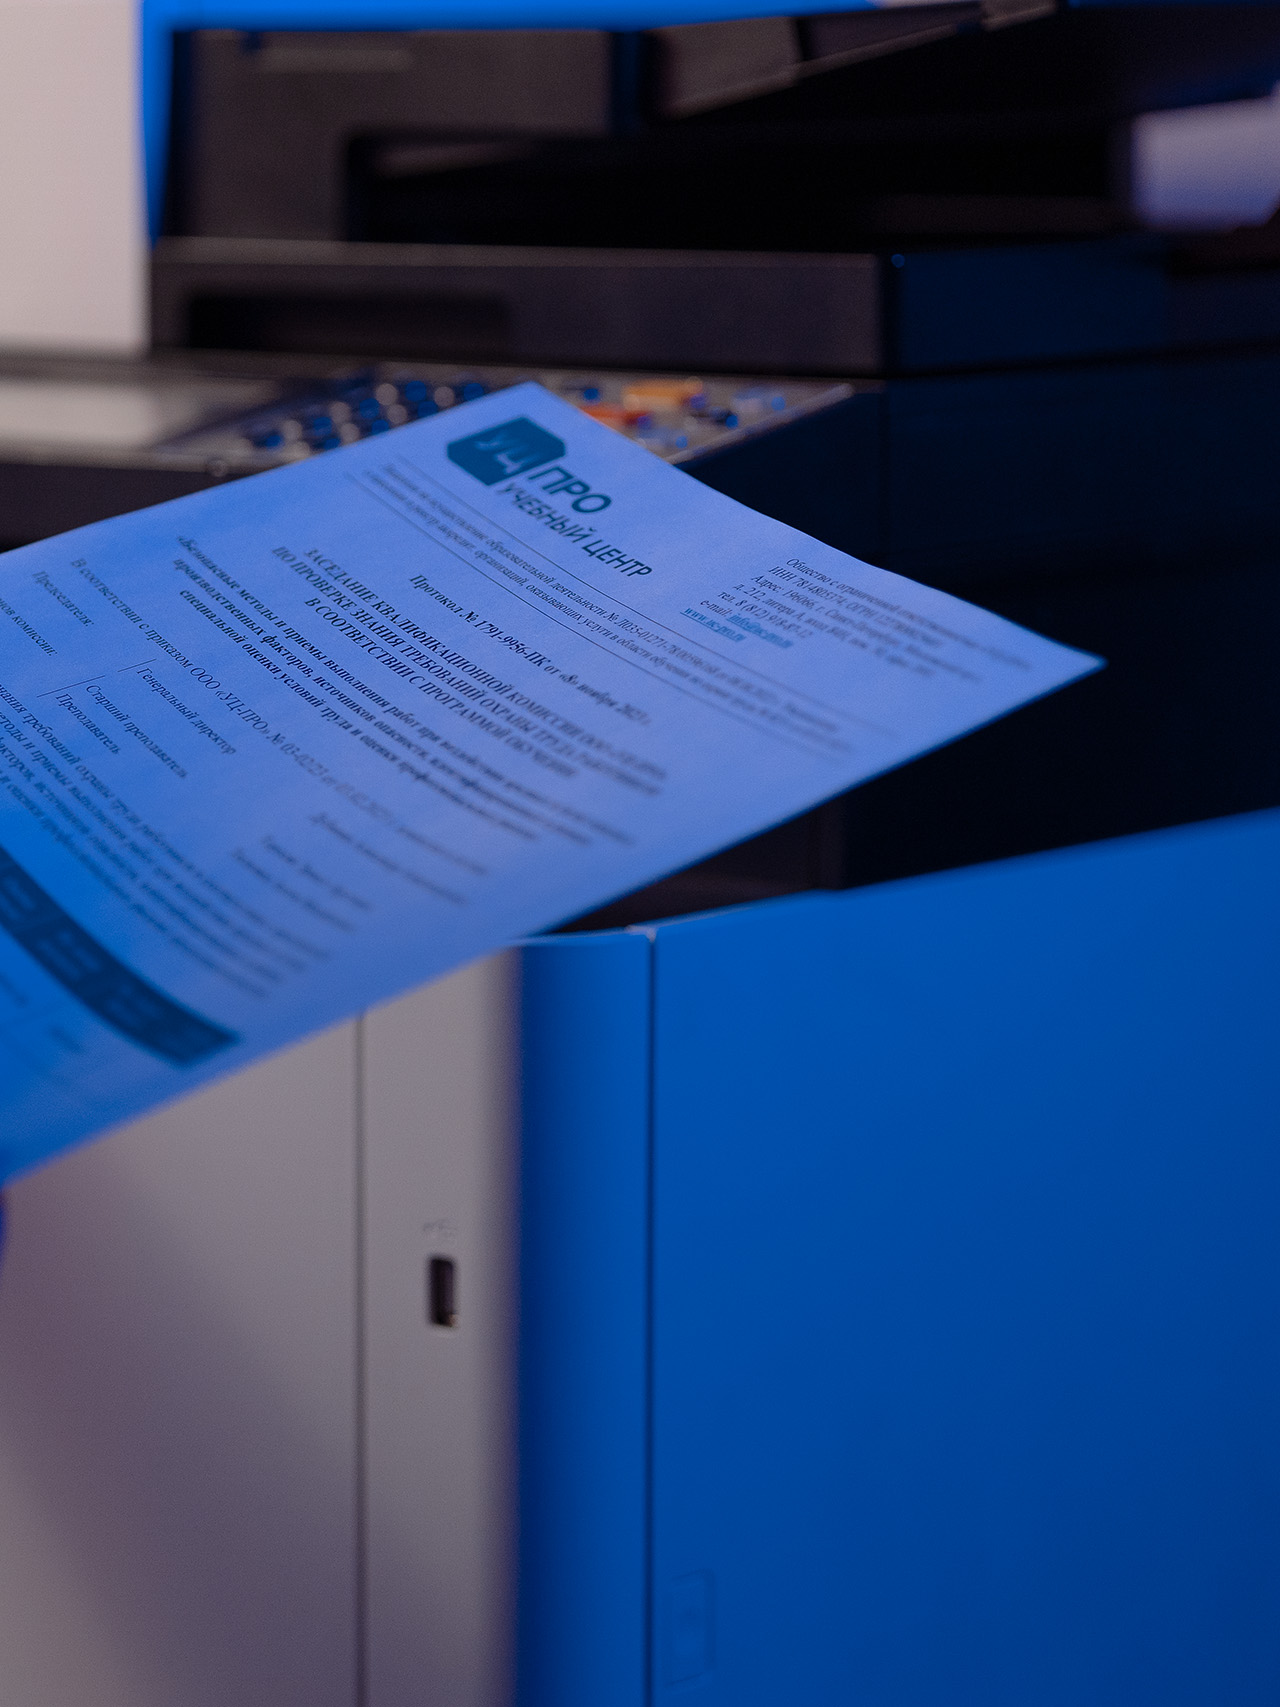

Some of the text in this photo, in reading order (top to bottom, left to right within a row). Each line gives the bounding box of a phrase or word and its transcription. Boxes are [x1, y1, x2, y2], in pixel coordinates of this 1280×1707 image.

[527, 465, 612, 514] ПРО
[498, 482, 653, 577] УЧЕБНЫЙ ЦЕНТР
[749, 574, 787, 593] Адрес:
[765, 566, 800, 581] ИНН
[782, 557, 835, 583] Общество
[77, 568, 144, 624] соответствии
[301, 548, 379, 602] ЗАСЕДАНИЕ
[369, 600, 516, 695] КВАЛИФИКАЦИОННОЙ
[302, 597, 323, 607] В
[406, 574, 466, 613] Протокол
[457, 610, 482, 623] №
[471, 619, 553, 667] 1791-9956-ПК
[9, 614, 60, 656] комиссии:
[136, 622, 150, 630] с
[142, 628, 194, 668] приказом
[176, 589, 250, 644] специальной
[237, 642, 283, 674] оценки
[274, 673, 328, 708] условий
[234, 588, 281, 621] методы
[271, 619, 289, 628] и
[280, 627, 328, 661] приемы
[319, 659, 392, 708] выполнения
[288, 561, 359, 610] ПРОВЕРКЕ
[347, 608, 408, 647] ЗНАНИЯ
[396, 644, 490, 701] ТРЕБОВАНИЙ
[311, 604, 416, 677] СООТВЕТСТВИИ
[82, 683, 133, 722] Старший
[185, 666, 224, 690] ООО
[260, 633, 316, 678] факторов,
[309, 675, 379, 722] источников
[405, 674, 426, 685] С
[52, 692, 125, 755] Преподаватель
[134, 666, 202, 720] Генеральный
[187, 718, 240, 756] директор
[210, 689, 275, 735] «УЦ-ПРО»
[20, 712, 84, 765] требований
